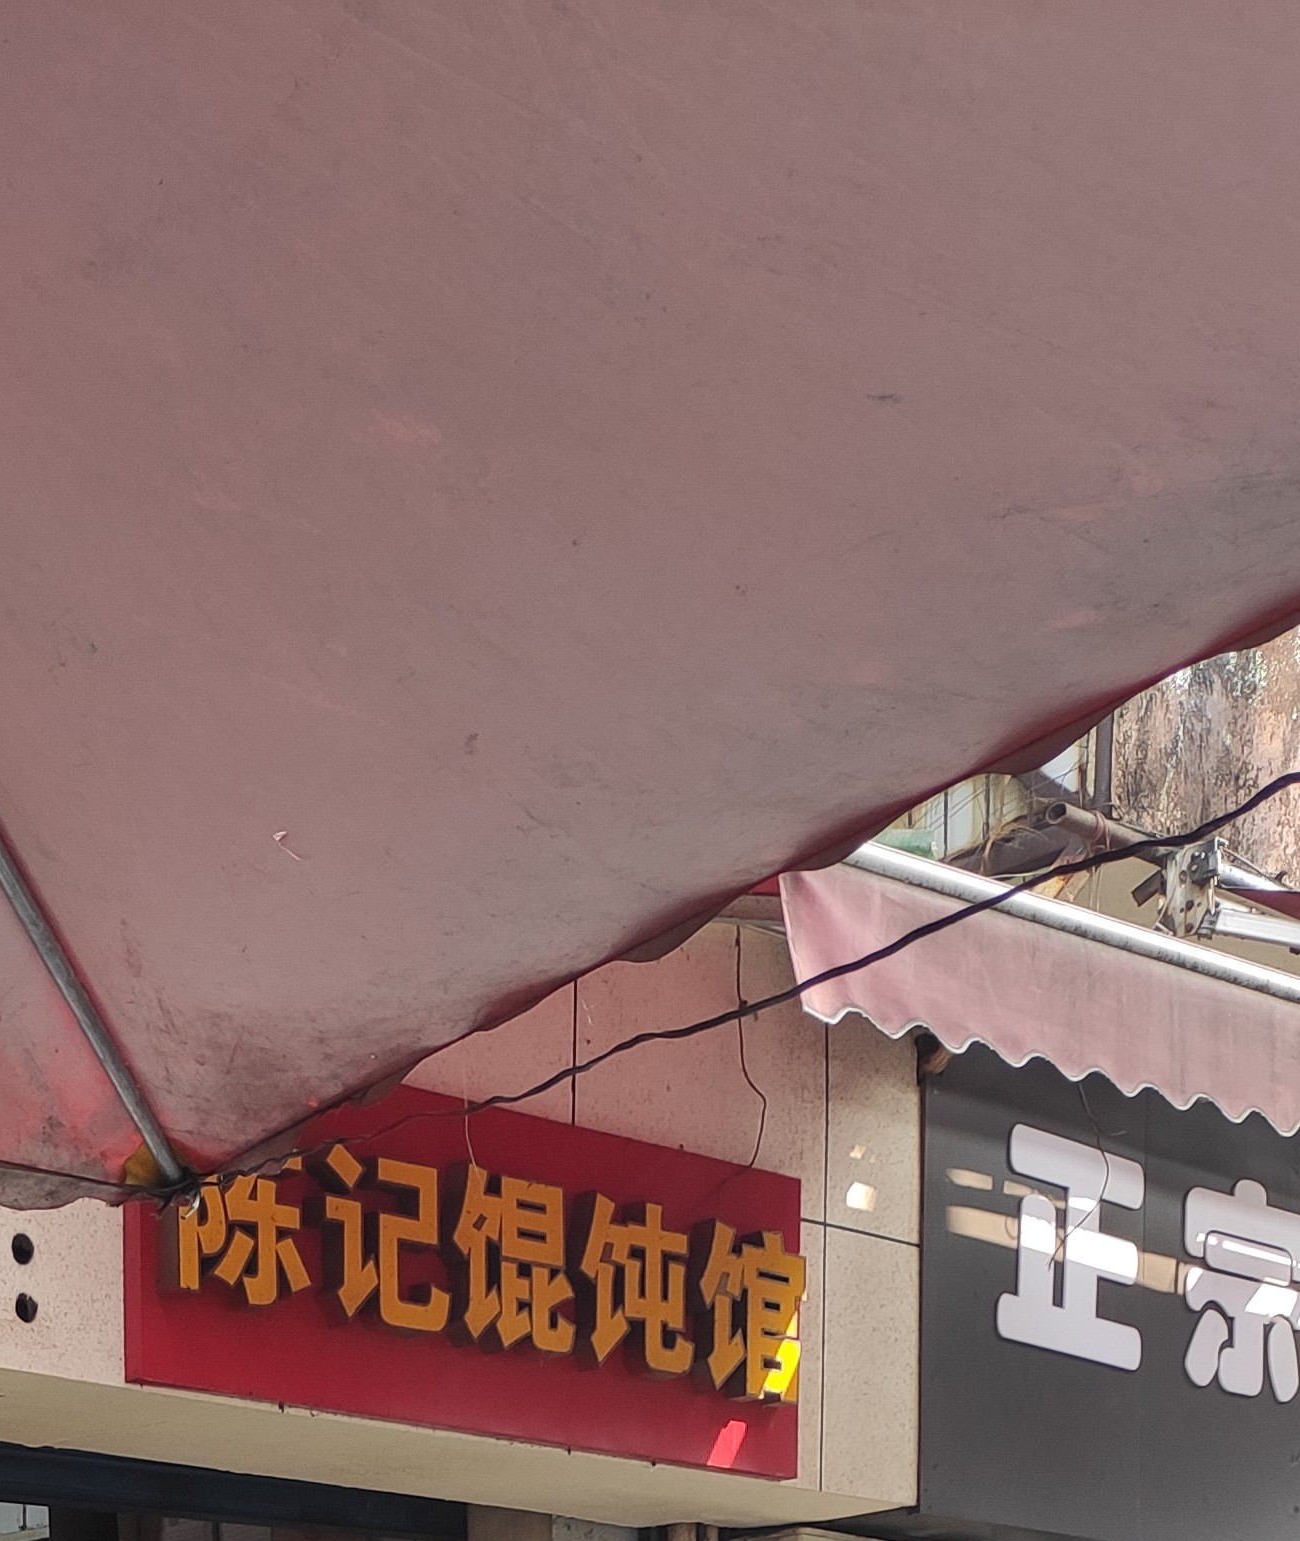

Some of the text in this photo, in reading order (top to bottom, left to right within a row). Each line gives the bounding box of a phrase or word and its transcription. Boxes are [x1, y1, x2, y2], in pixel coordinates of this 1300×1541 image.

[178, 1143, 807, 1404] 陈记馄饨馆
[996, 1123, 1300, 1402] 正宗
